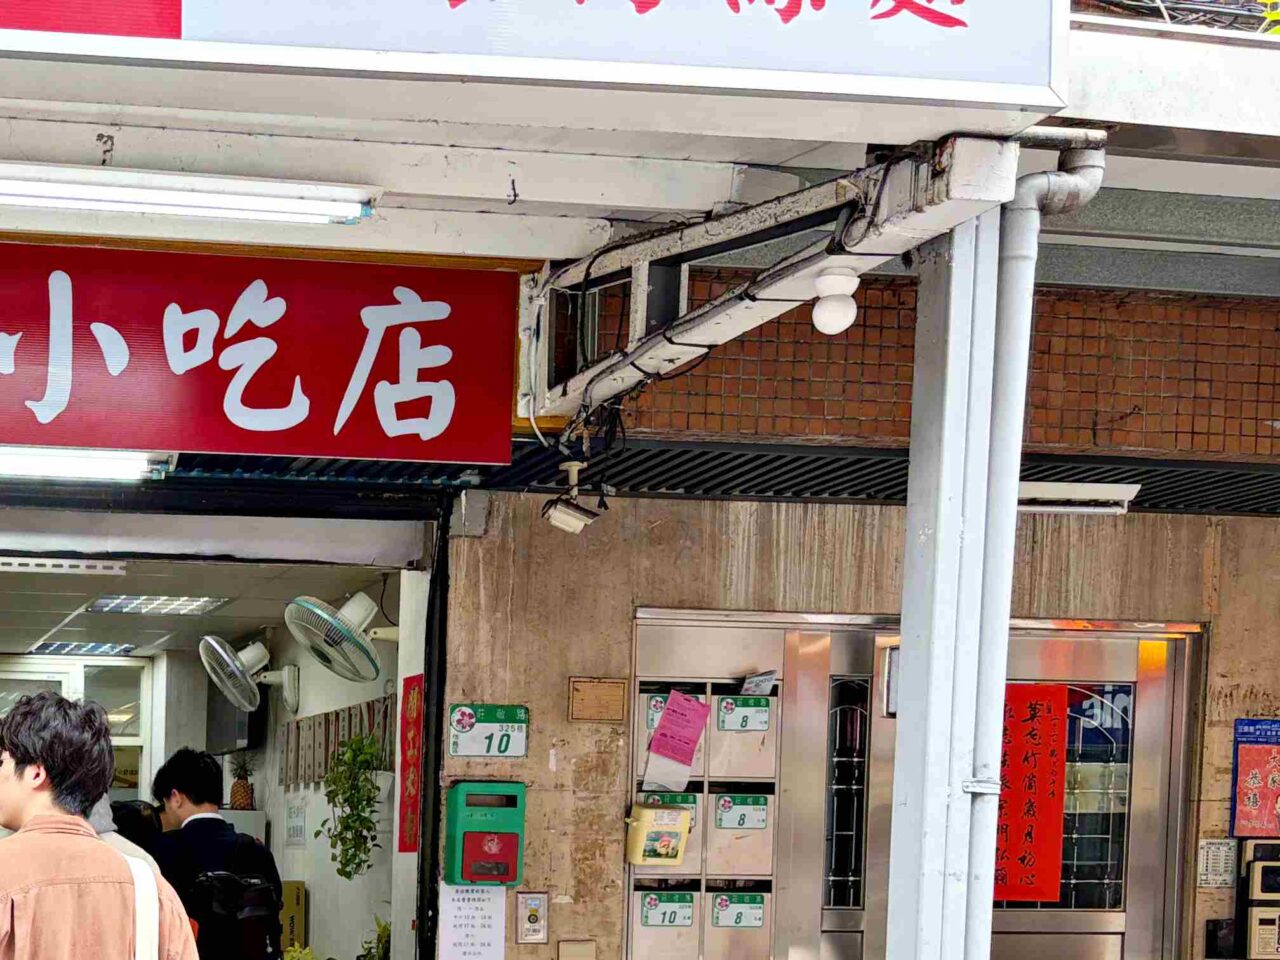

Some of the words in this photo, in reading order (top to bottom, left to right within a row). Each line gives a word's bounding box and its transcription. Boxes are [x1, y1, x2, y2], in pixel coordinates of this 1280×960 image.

[740, 715, 749, 728] 8
[484, 732, 511, 754] 10
[738, 813, 746, 826] 8
[661, 910, 678, 924] 10
[734, 911, 743, 925] 8
